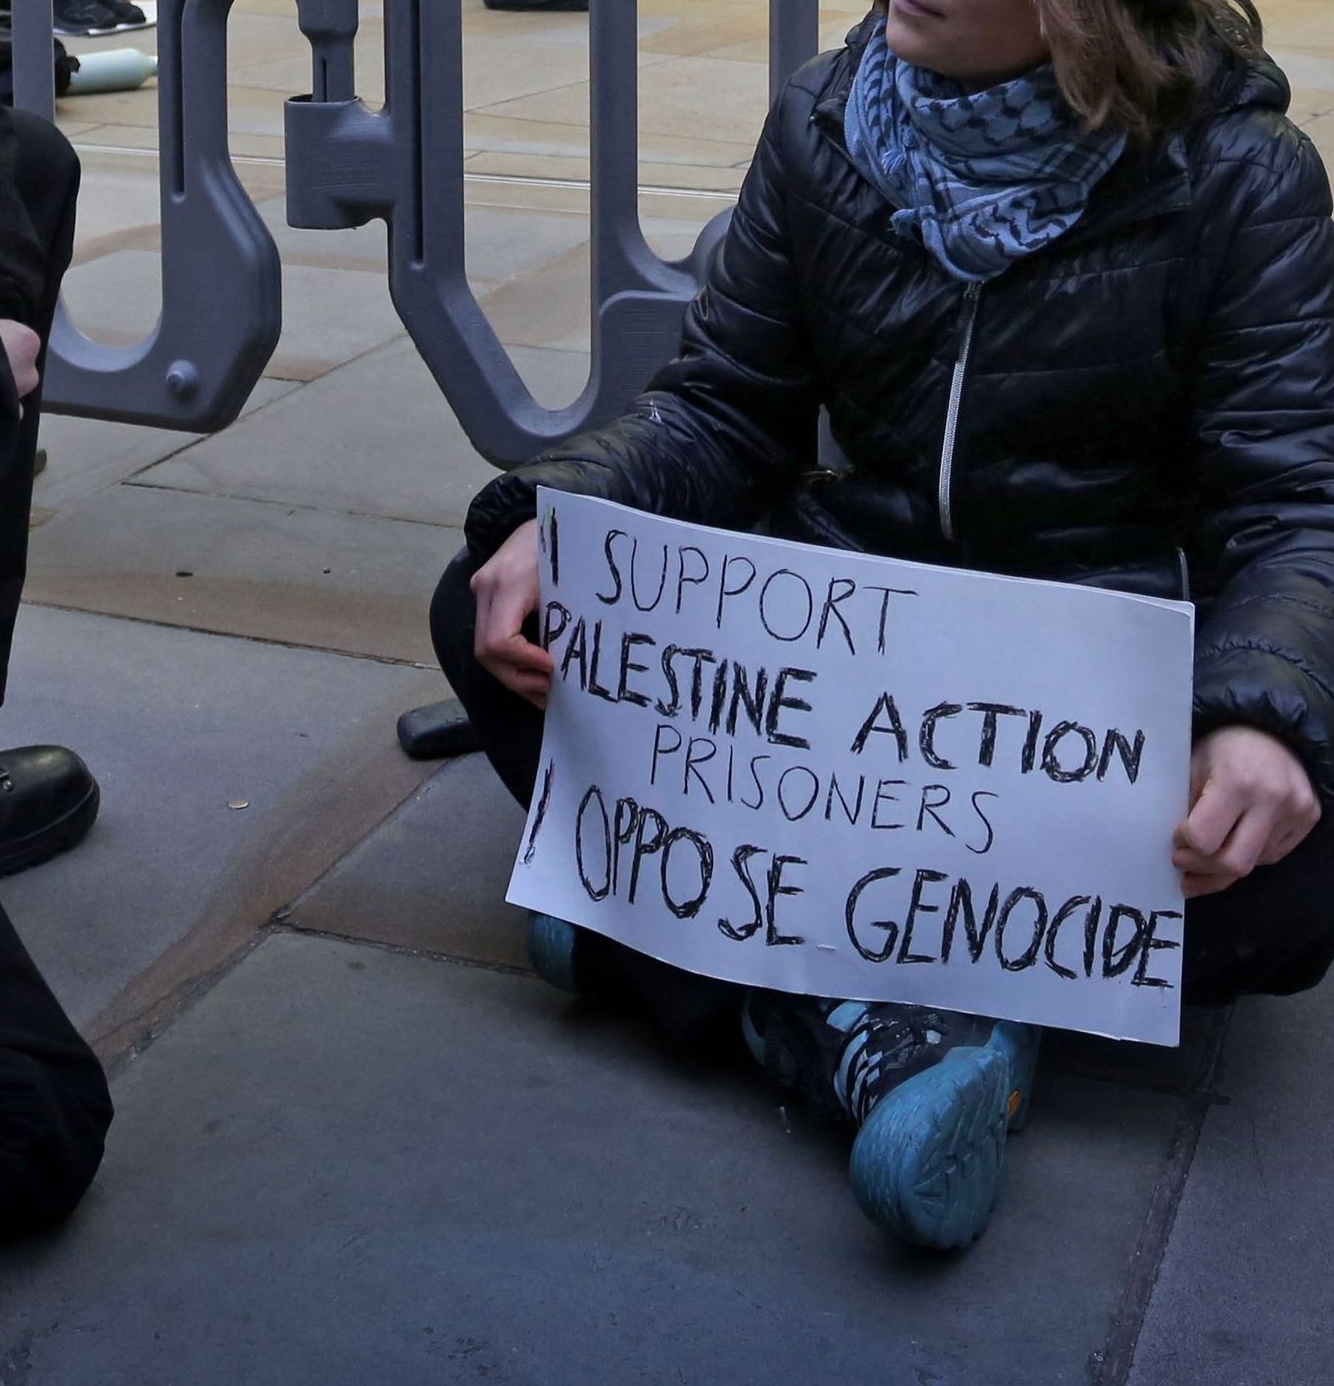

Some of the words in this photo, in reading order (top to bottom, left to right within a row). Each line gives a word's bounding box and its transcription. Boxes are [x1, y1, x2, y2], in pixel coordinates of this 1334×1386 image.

[596, 529, 918, 655] SUPPORT
[542, 600, 818, 750] PALESTINE
[851, 691, 1146, 784] ACTION
[650, 723, 1000, 854] PRISONERS
[524, 758, 554, 867] I
[575, 783, 809, 947] OPPOSE
[844, 866, 1184, 989] GENOCIDE
